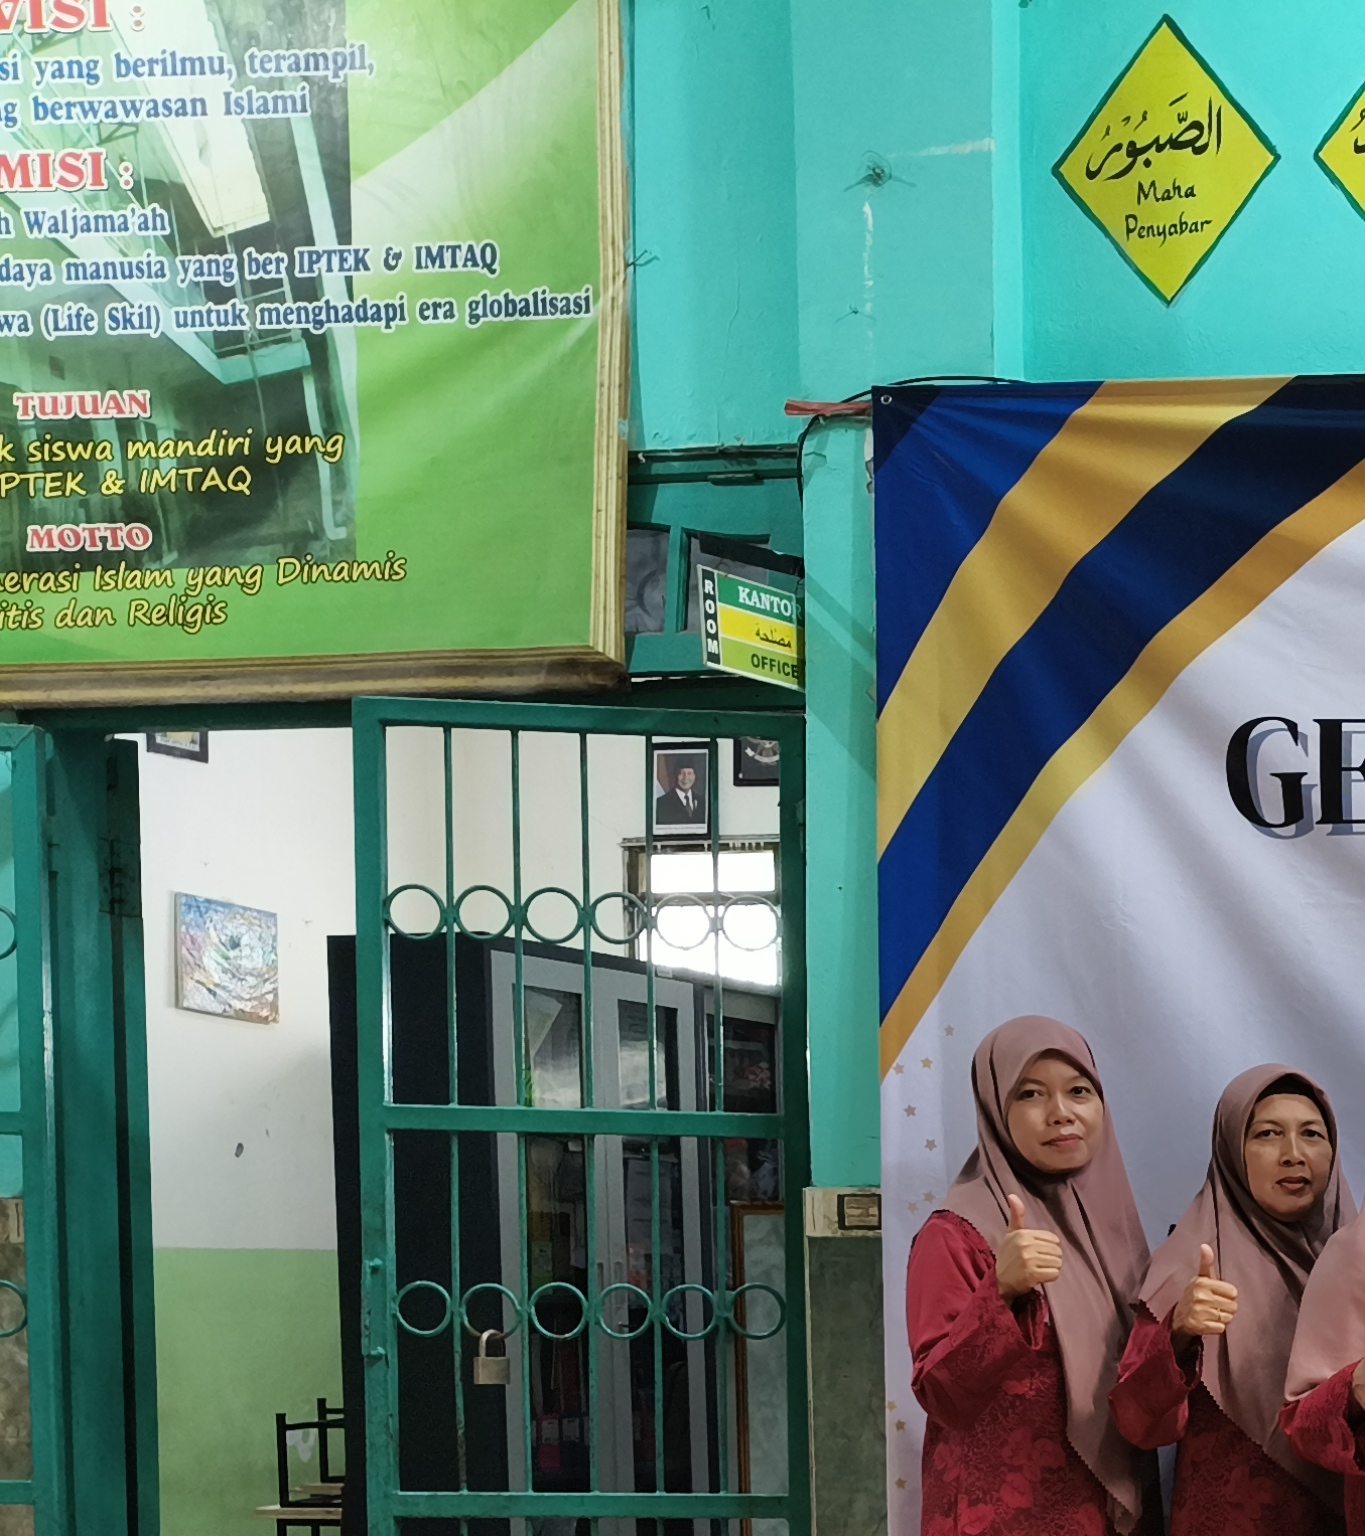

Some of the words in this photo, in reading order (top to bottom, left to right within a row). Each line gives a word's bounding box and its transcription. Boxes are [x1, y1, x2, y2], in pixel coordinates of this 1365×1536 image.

[35, 58, 100, 86] yang
[115, 49, 234, 81] berilmu,
[249, 44, 375, 76] terampil,
[33, 95, 207, 121] berwawasan
[223, 87, 309, 116] Islami
[0, 151, 105, 188] MISI
[1137, 178, 1197, 205] Maha
[1125, 211, 1213, 248] Penyabar
[65, 252, 166, 281] manusia
[179, 254, 235, 284] yang
[247, 250, 285, 276] ber
[297, 248, 370, 274] IPTEK
[384, 249, 402, 268] &
[415, 241, 498, 275] IMTAQ
[43, 306, 96, 338] (Life
[108, 303, 161, 338] Skil)
[175, 302, 247, 329] untuk
[258, 297, 406, 331] menghadapi
[418, 302, 455, 321] era
[468, 288, 592, 323] globalisasi
[16, 392, 149, 417] TUJUAN
[28, 434, 114, 462] siswa
[127, 428, 253, 459] mandiri
[265, 432, 344, 464] yang
[101, 470, 126, 496] &
[139, 465, 252, 496] IMTAQ
[29, 526, 150, 549] MOTTO
[0, 563, 80, 593] erasi
[94, 561, 173, 591] Islam
[186, 563, 264, 596] yang
[276, 550, 407, 585] Dinamis
[55, 598, 115, 628] dan
[128, 595, 228, 634] Religis
[704, 579, 719, 655] ROOM
[751, 653, 799, 680] OFFICE
